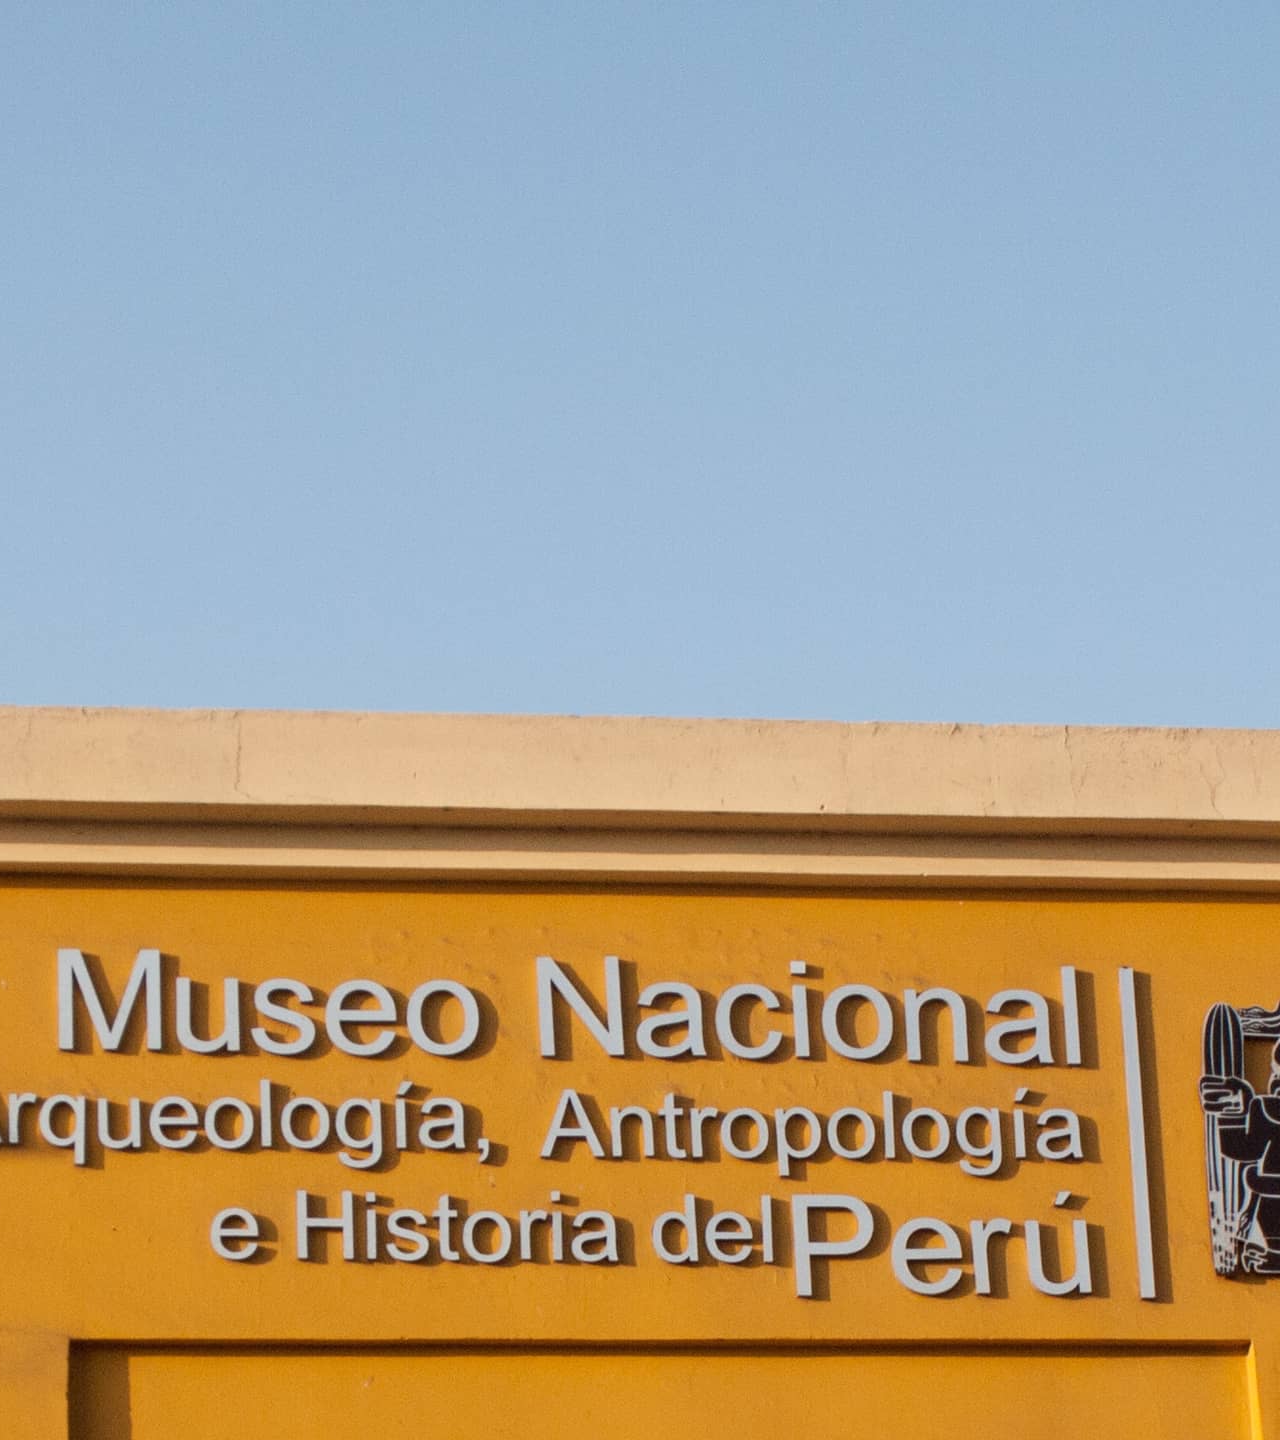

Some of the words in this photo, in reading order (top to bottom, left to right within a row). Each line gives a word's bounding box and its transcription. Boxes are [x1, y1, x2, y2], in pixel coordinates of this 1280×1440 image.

[57, 948, 480, 1057] Museo
[536, 955, 1082, 1066] Nacional
[540, 1087, 1084, 1177] Antropología
[210, 1205, 260, 1261] e
[296, 1189, 618, 1264] Historia
[652, 1193, 774, 1264] del
[791, 1190, 1093, 1298] Perú
